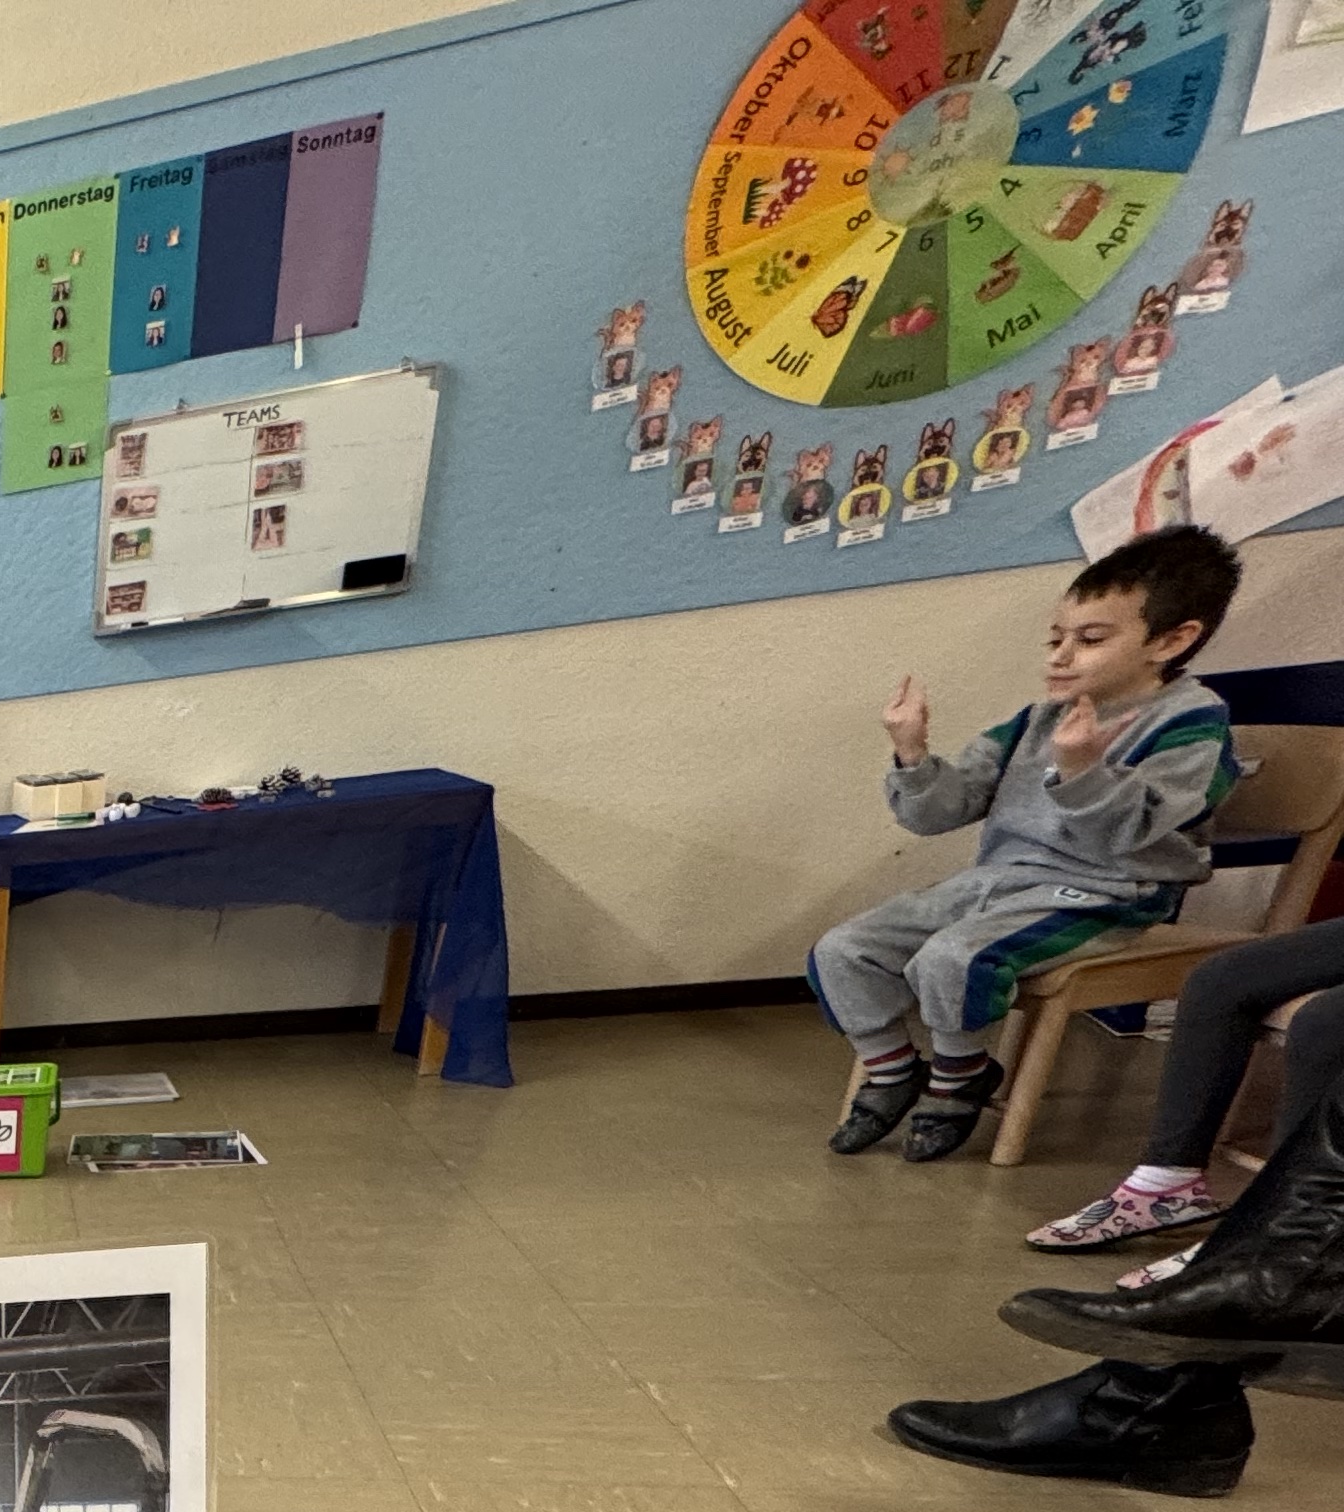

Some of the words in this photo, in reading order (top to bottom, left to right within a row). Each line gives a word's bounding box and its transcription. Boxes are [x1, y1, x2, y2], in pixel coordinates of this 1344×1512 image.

[944, 50, 981, 79] 12
[987, 55, 1011, 80] 1
[729, 37, 812, 144] Oktober
[896, 69, 931, 104] 11
[1013, 80, 1040, 106] 2
[296, 123, 376, 154] Sonntag
[854, 113, 890, 151] 10
[129, 164, 193, 194] Freitag
[843, 168, 868, 187] 9
[999, 177, 1023, 198] 4
[13, 183, 115, 221] Donnerstag
[704, 151, 741, 257] September
[846, 208, 872, 232] 8
[965, 207, 984, 234] 5
[1095, 201, 1147, 260] April
[875, 230, 899, 253] 7
[919, 229, 934, 251] 6
[704, 267, 753, 348] August
[986, 303, 1042, 349] Mai
[766, 343, 814, 377] Juli
[865, 363, 914, 390] Juni
[223, 404, 280, 428] TEAMS
